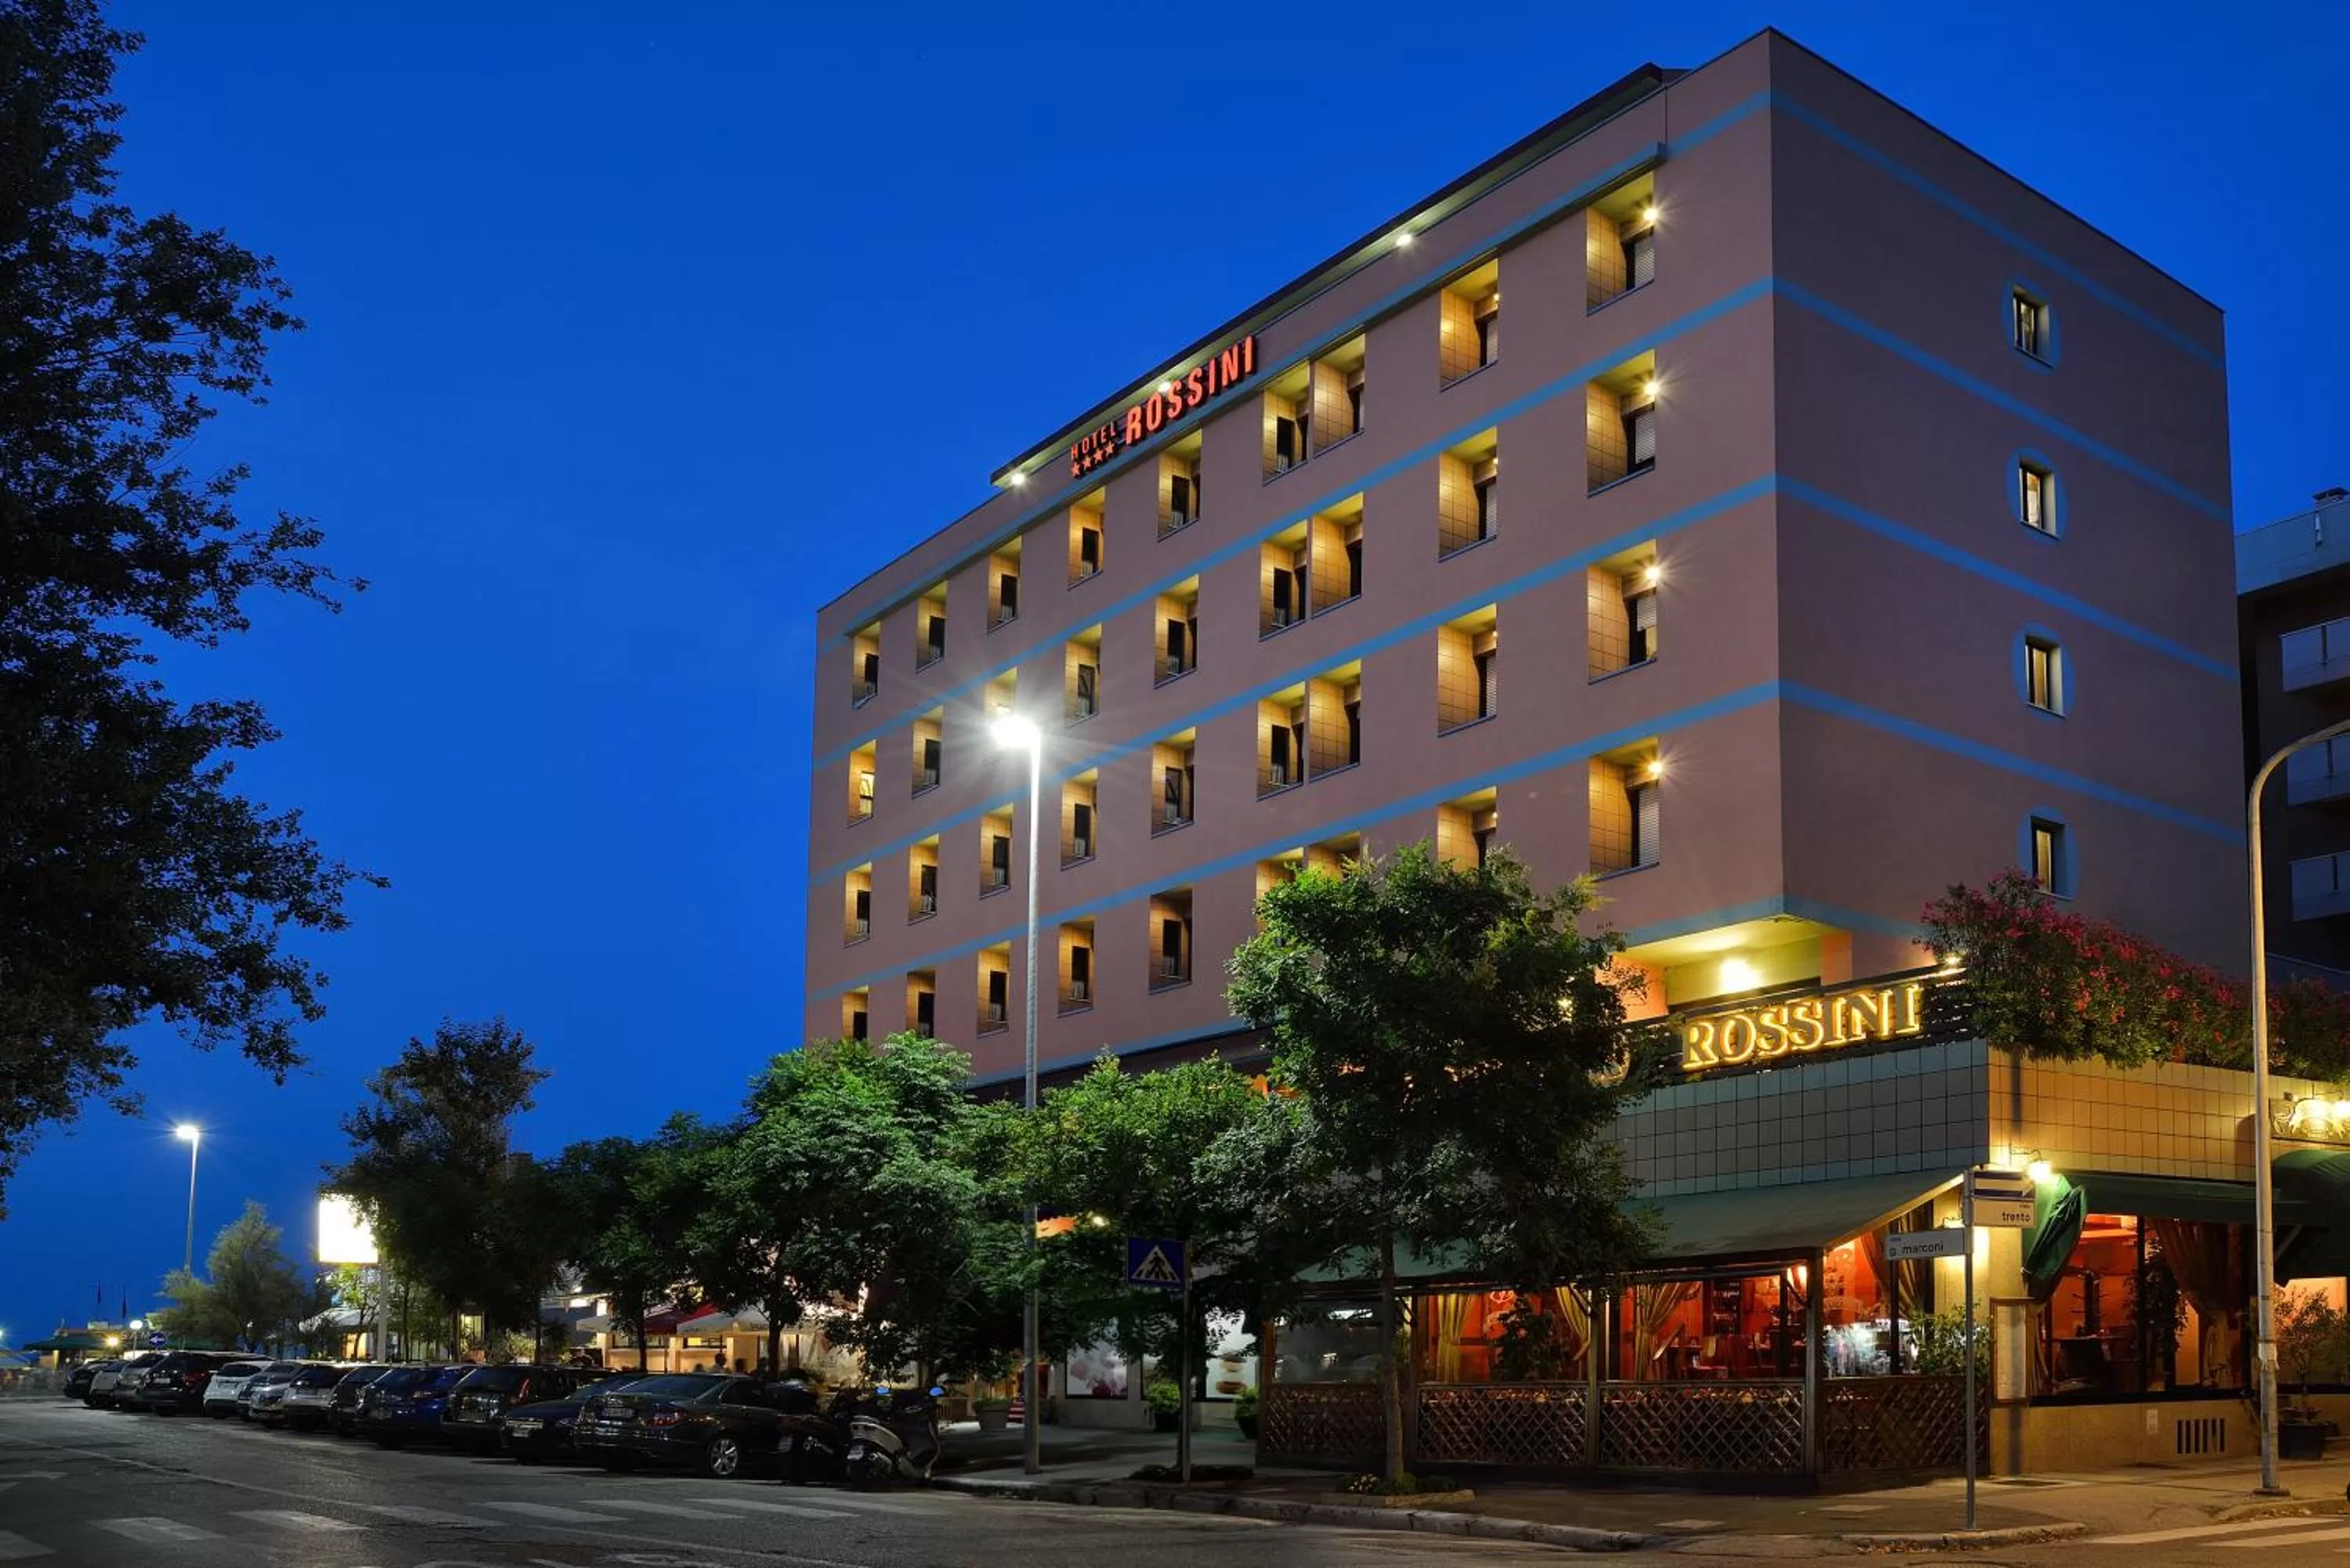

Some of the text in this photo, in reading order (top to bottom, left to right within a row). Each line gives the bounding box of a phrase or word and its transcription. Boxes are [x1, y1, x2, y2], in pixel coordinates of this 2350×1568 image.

[1071, 335, 1256, 461] HOTEL ROSSINI
[1682, 981, 1924, 1071] ROSSINI
[2001, 1211, 2031, 1223] trento
[1902, 1241, 1943, 1254] marconi
